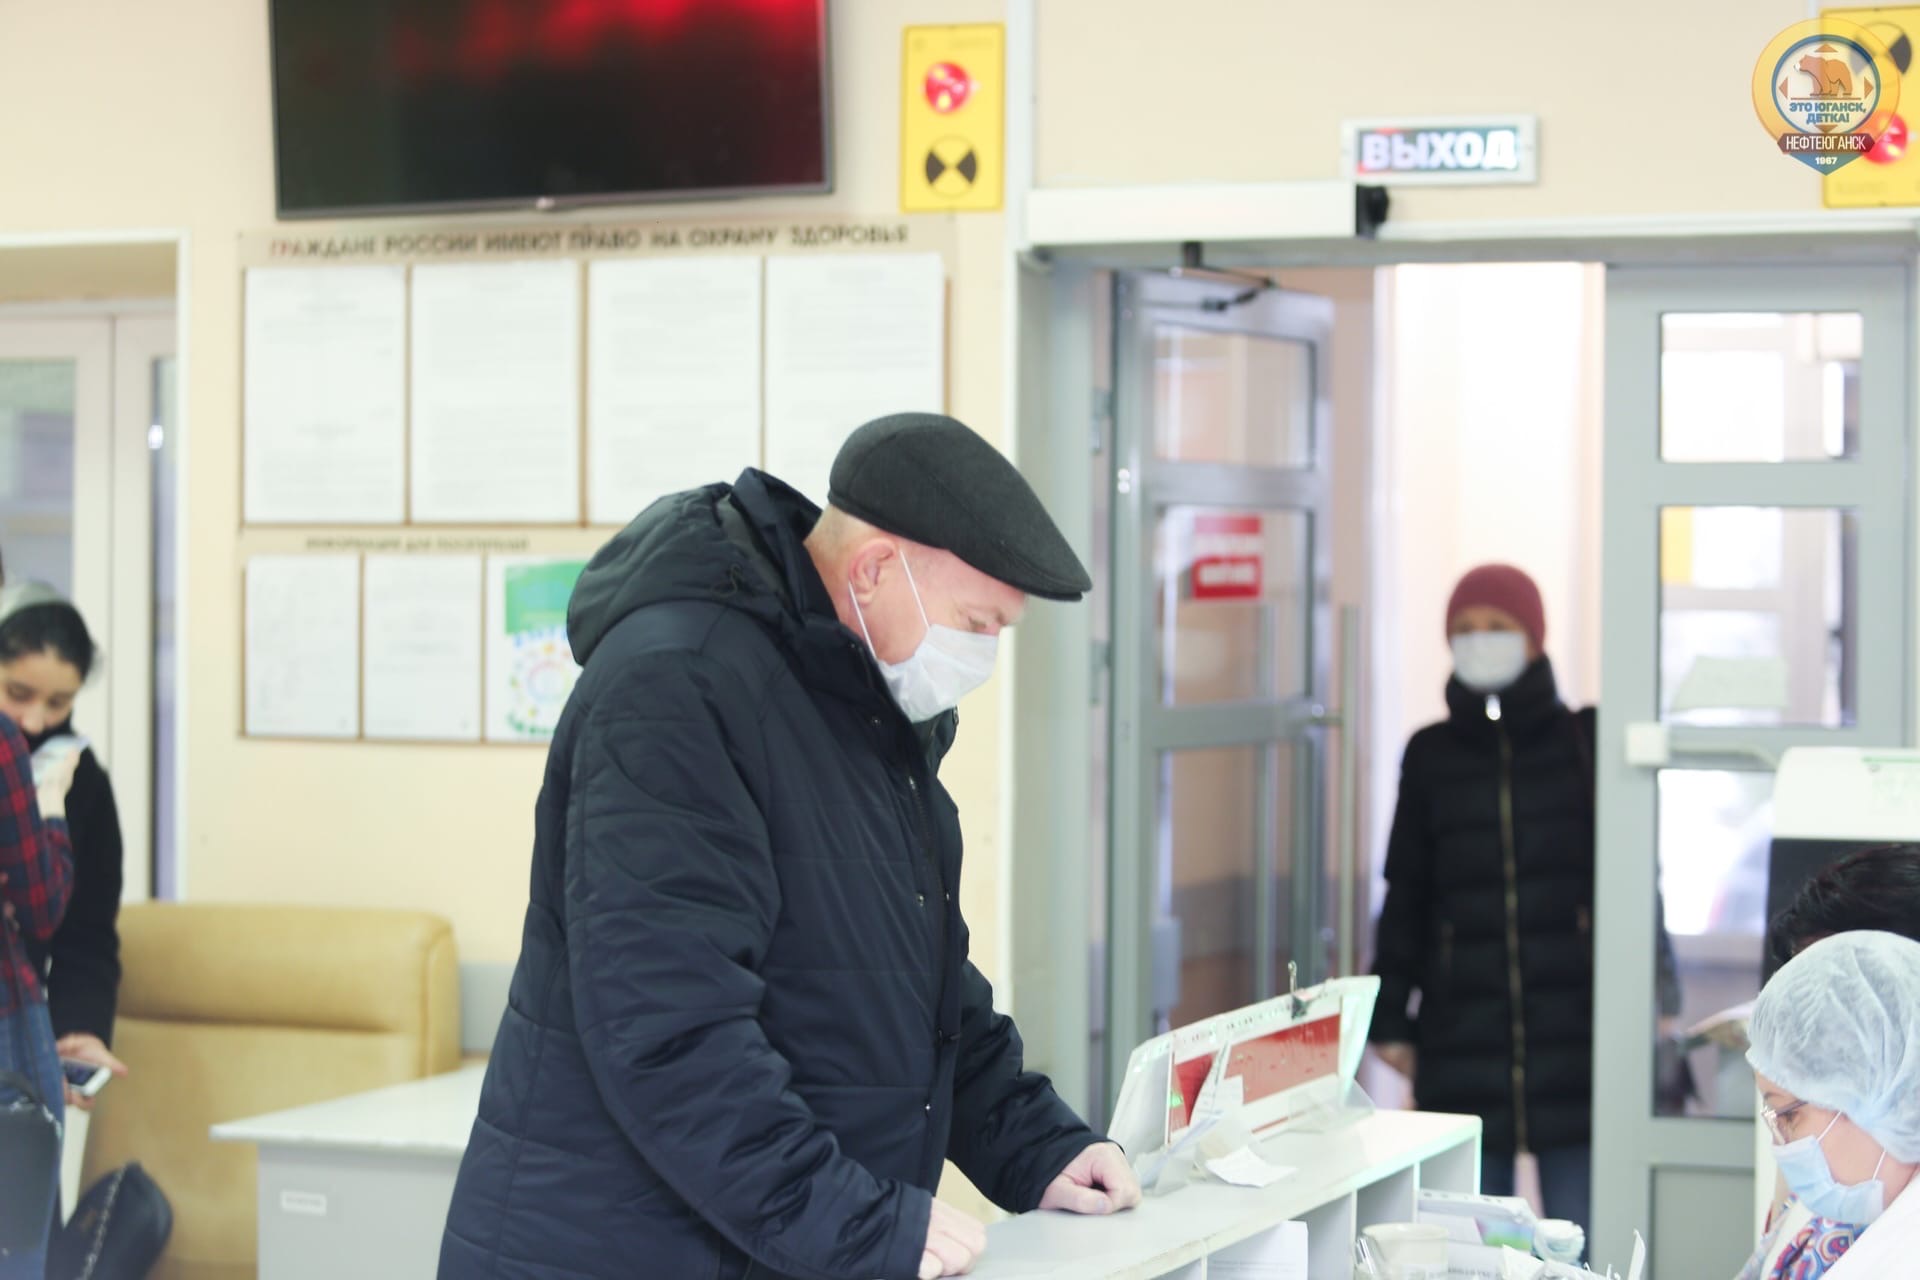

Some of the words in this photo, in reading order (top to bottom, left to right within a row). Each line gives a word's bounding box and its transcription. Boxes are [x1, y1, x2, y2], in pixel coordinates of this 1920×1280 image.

[1361, 130, 1518, 170] ВЫХОД
[271, 235, 376, 258] ГРАЖДАНЕ
[386, 233, 478, 254] РОССИИ
[485, 231, 562, 252] ИМЕЮТ
[570, 228, 642, 249] ПРАВО
[652, 228, 681, 247] НА
[688, 226, 778, 247] ОХРАНУ
[790, 223, 909, 246] ЗДОРОВЬЯ
